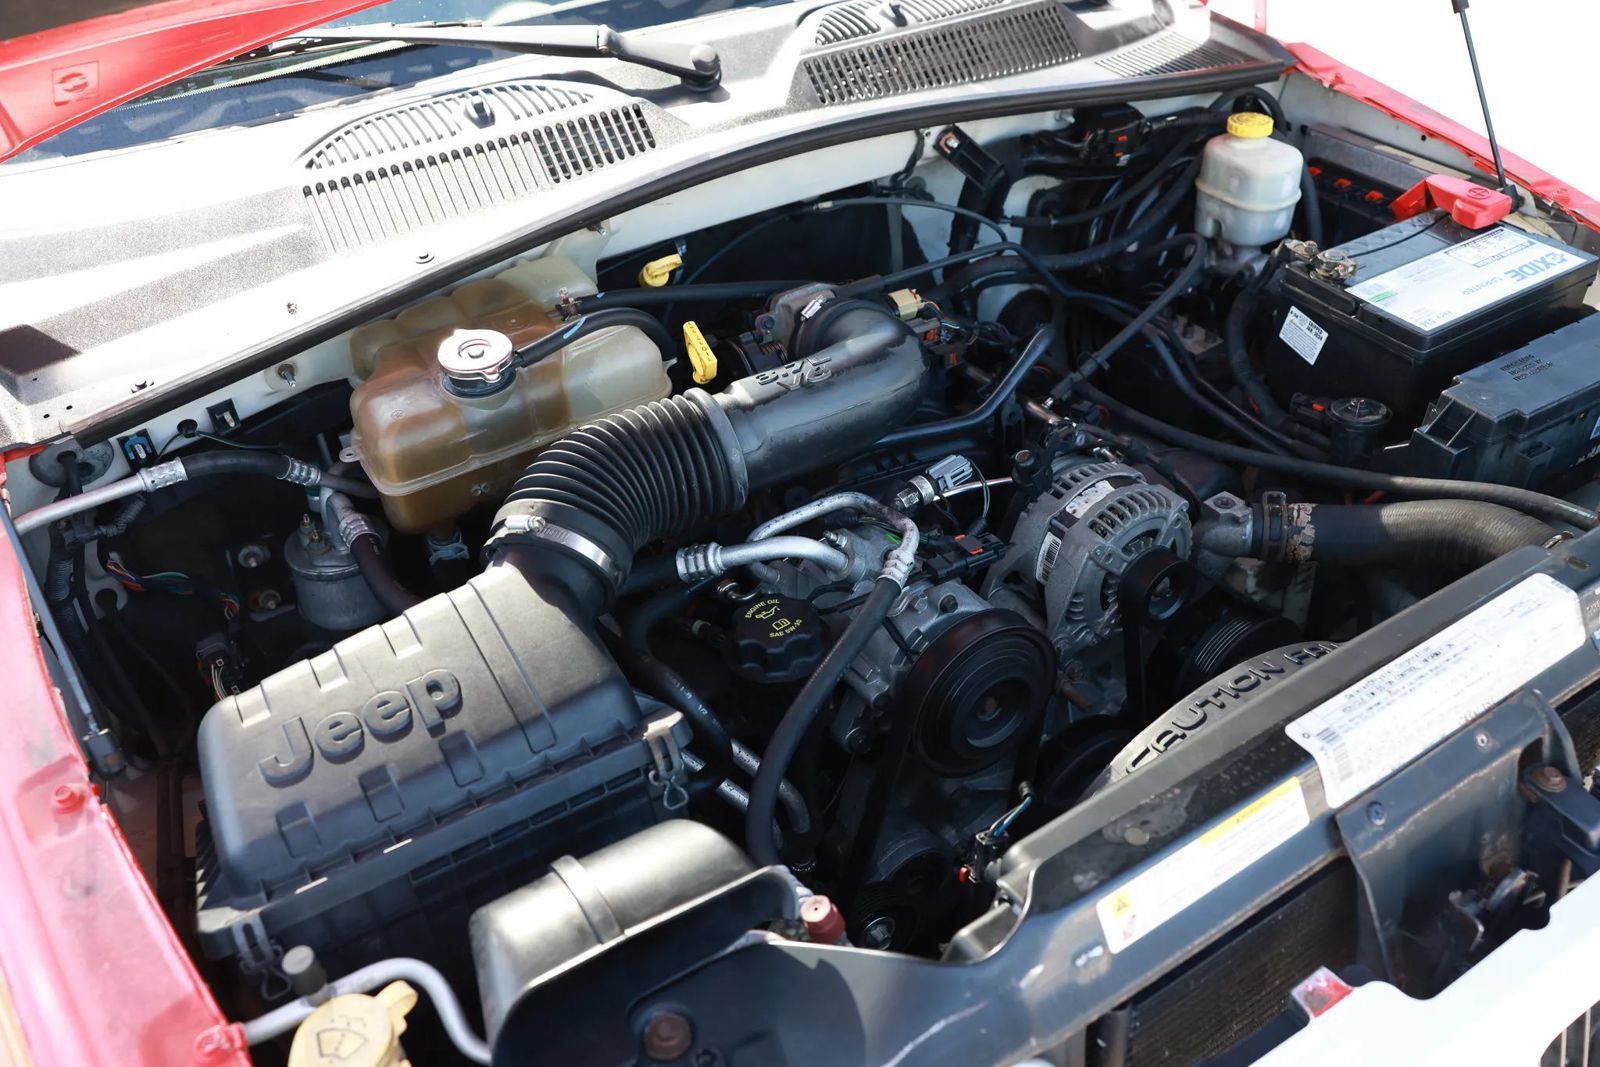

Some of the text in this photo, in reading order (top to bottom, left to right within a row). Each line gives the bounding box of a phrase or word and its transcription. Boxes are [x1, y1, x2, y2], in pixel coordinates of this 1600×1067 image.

[1504, 252, 1568, 282] EXIDE
[756, 357, 832, 386] 3.7L
[777, 367, 832, 391] V6
[745, 601, 766, 618] ENGINE
[257, 668, 463, 788] Jeep
